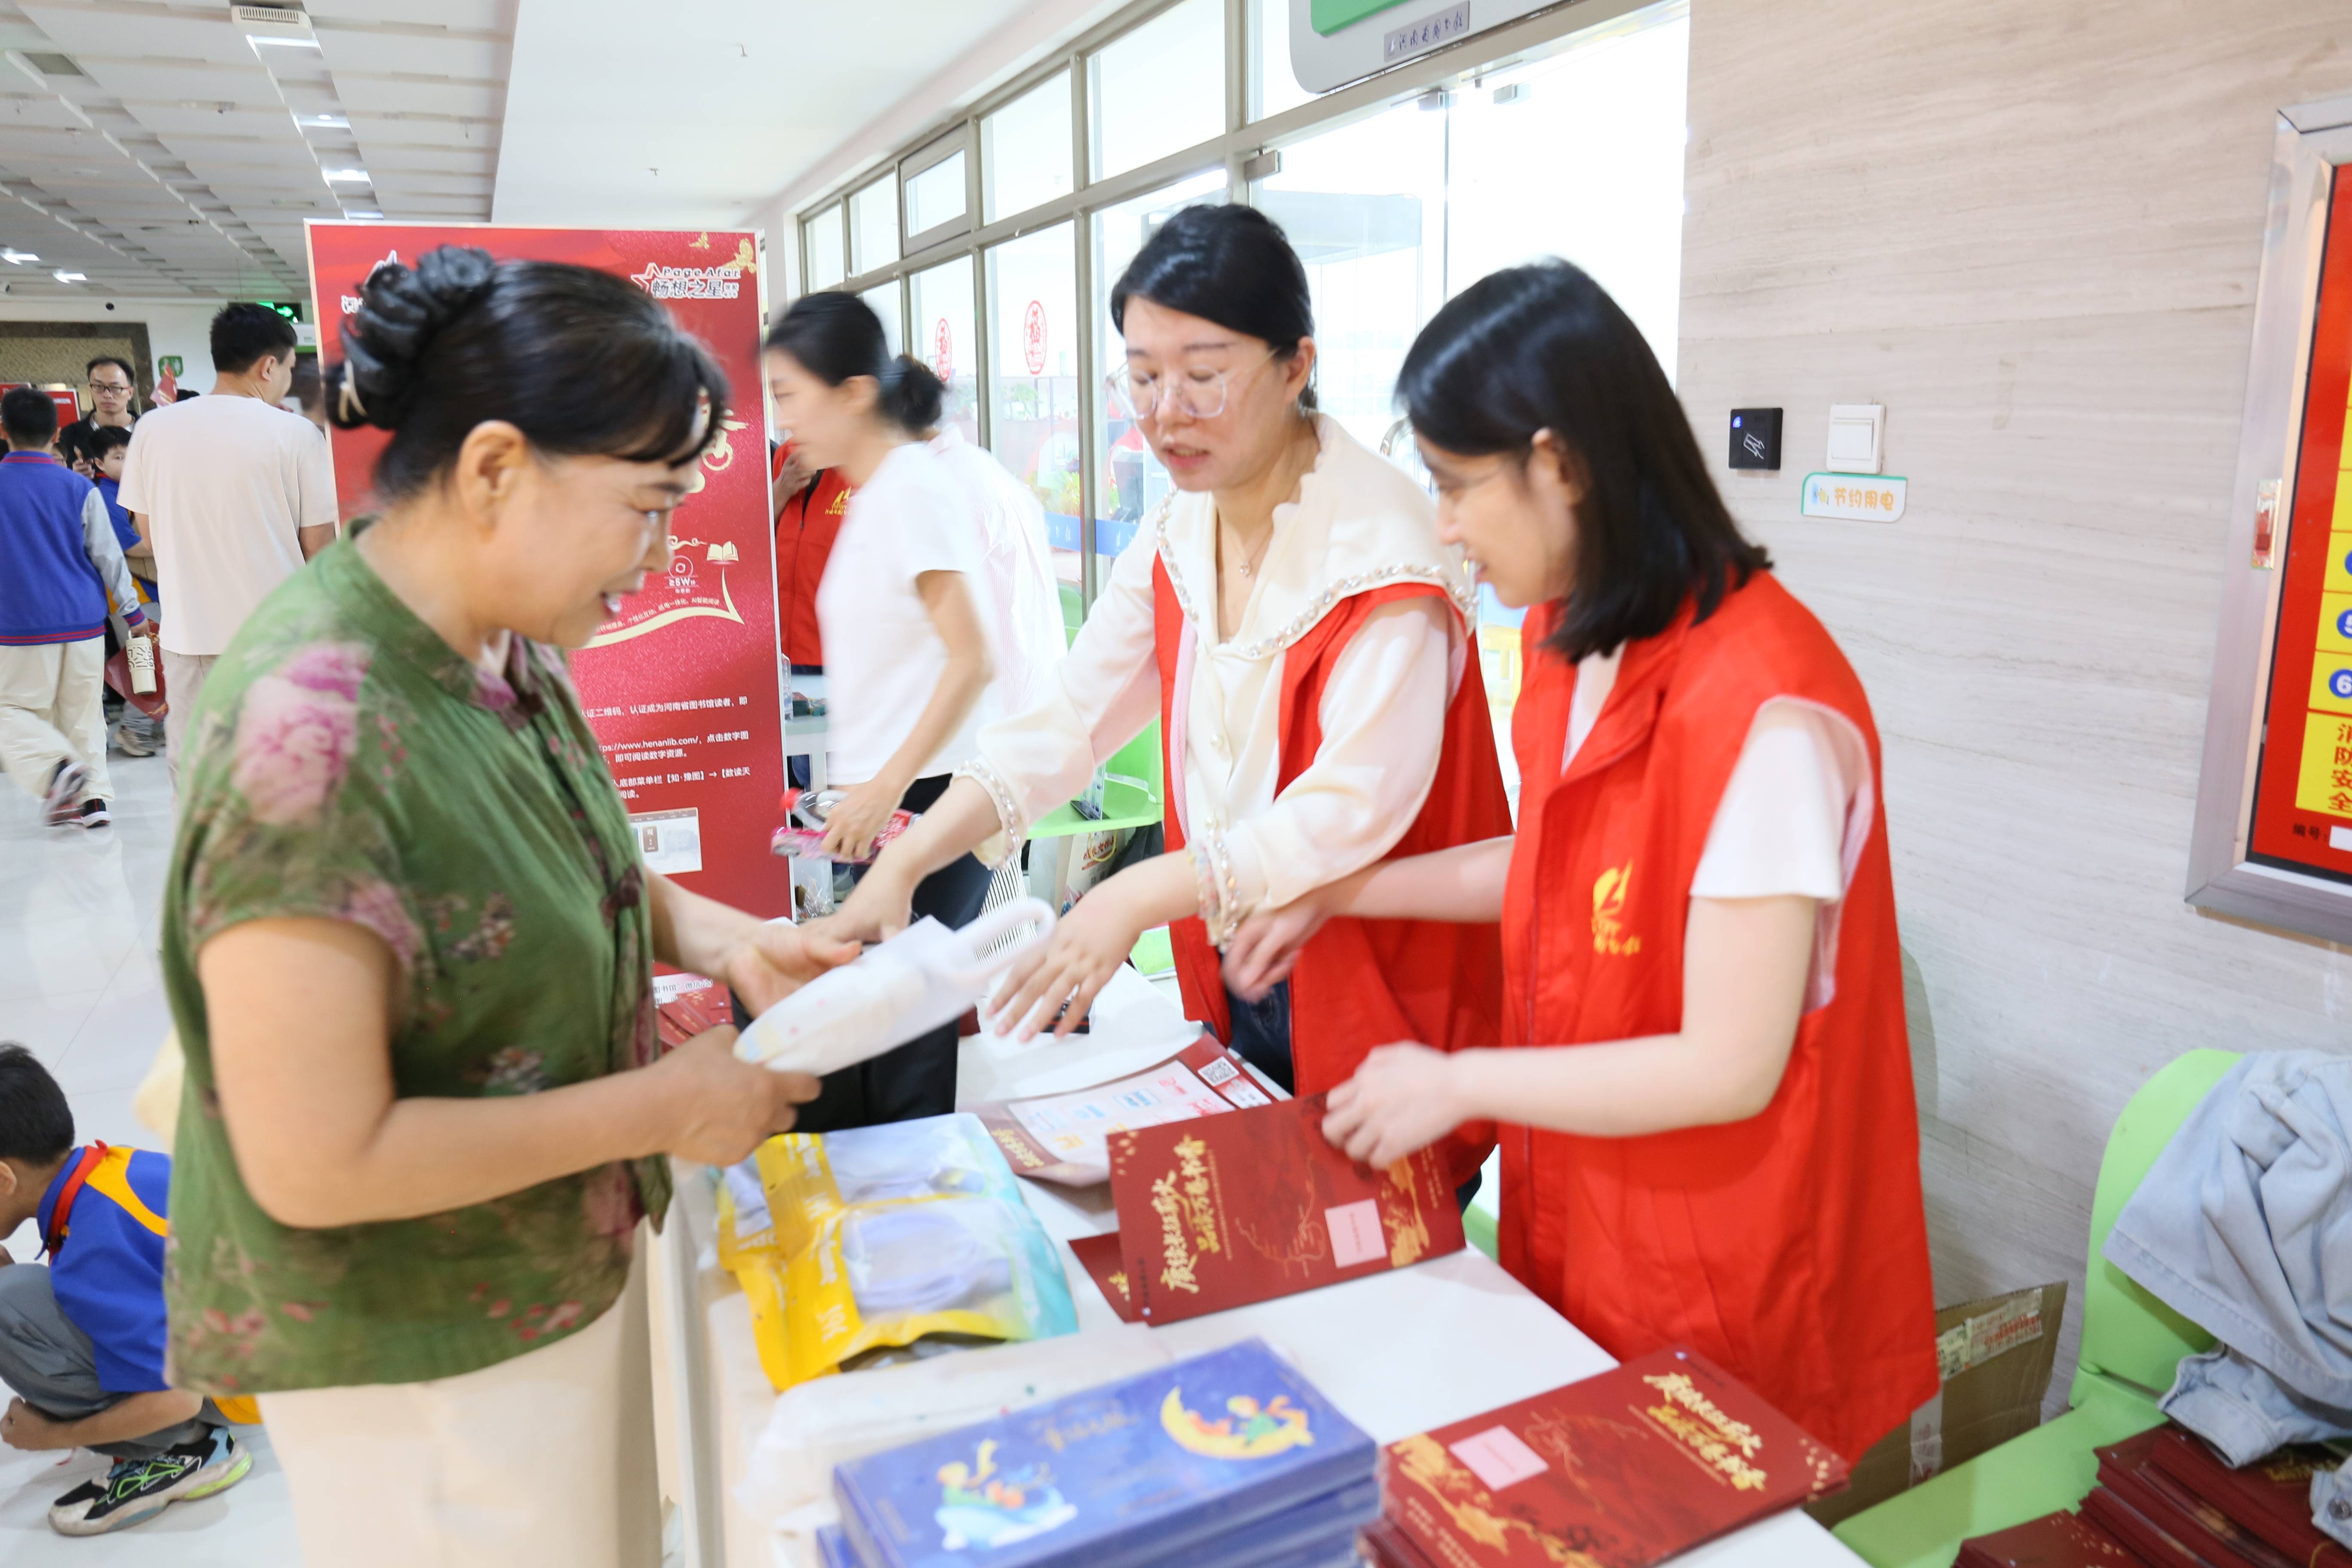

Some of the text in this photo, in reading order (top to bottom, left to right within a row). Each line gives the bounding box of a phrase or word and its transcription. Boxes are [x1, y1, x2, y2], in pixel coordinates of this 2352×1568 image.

[663, 267, 740, 278] Page Afar
[652, 280, 722, 297] 畅想之星
[1834, 487, 1894, 511] 节约用电
